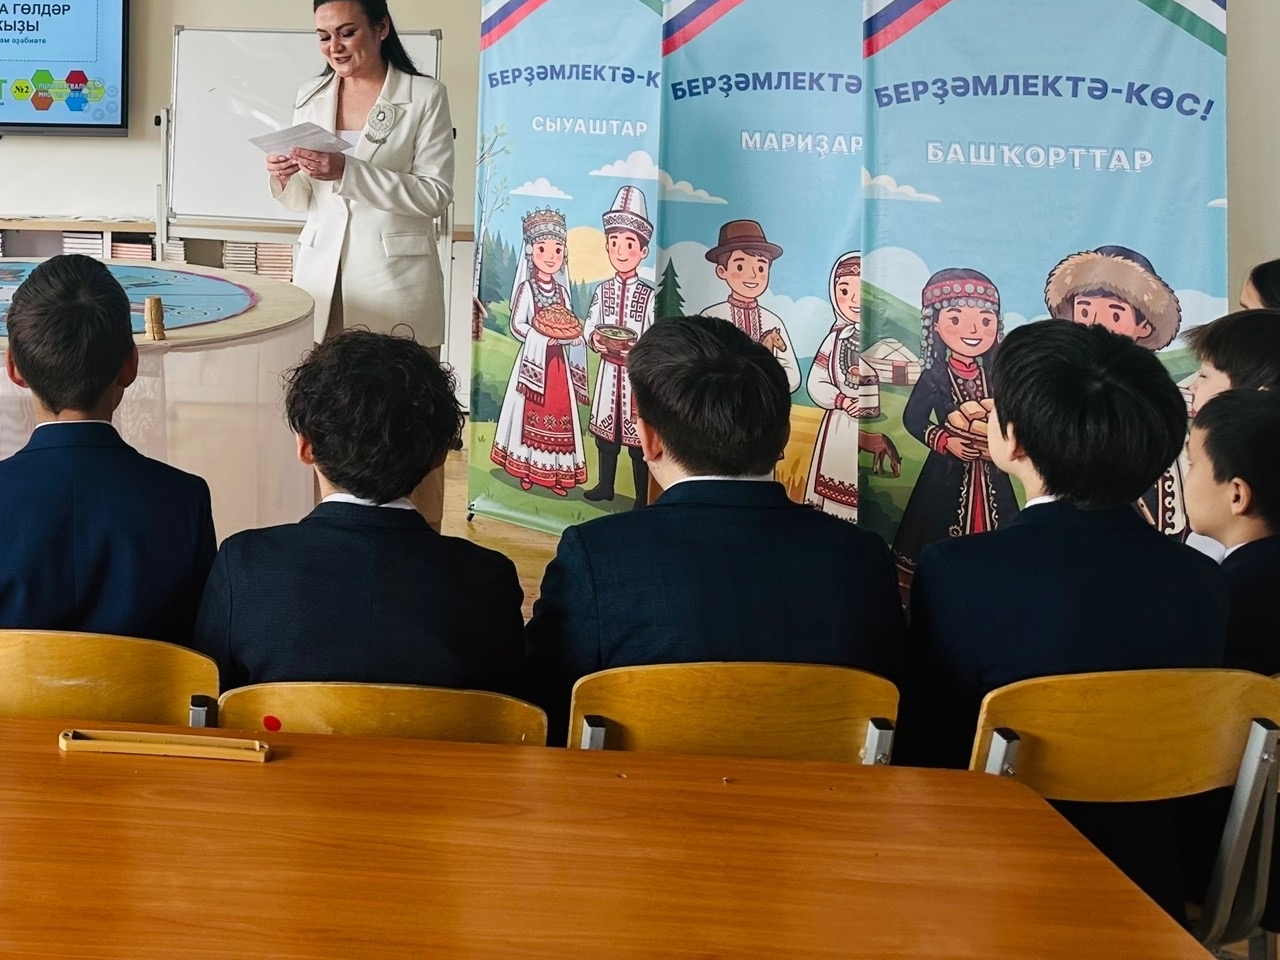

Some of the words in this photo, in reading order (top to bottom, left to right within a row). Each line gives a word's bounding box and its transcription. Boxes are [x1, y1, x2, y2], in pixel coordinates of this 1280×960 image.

[13, 3, 71, 17] ГӨЛДӘР
[13, 85, 30, 94] №2
[487, 64, 661, 89] БЕРҘӘМЛЕКТӘ-К
[670, 71, 863, 101] БЕРҘӘМЛЕКТӘ
[874, 74, 1216, 122] БЕРҘӘМЛЕКТӘ-КӨС!
[531, 115, 648, 137] СЫУАШТАР
[741, 129, 863, 158] МАРИҘАР
[926, 142, 1154, 173] БАШҠОРТТАР
